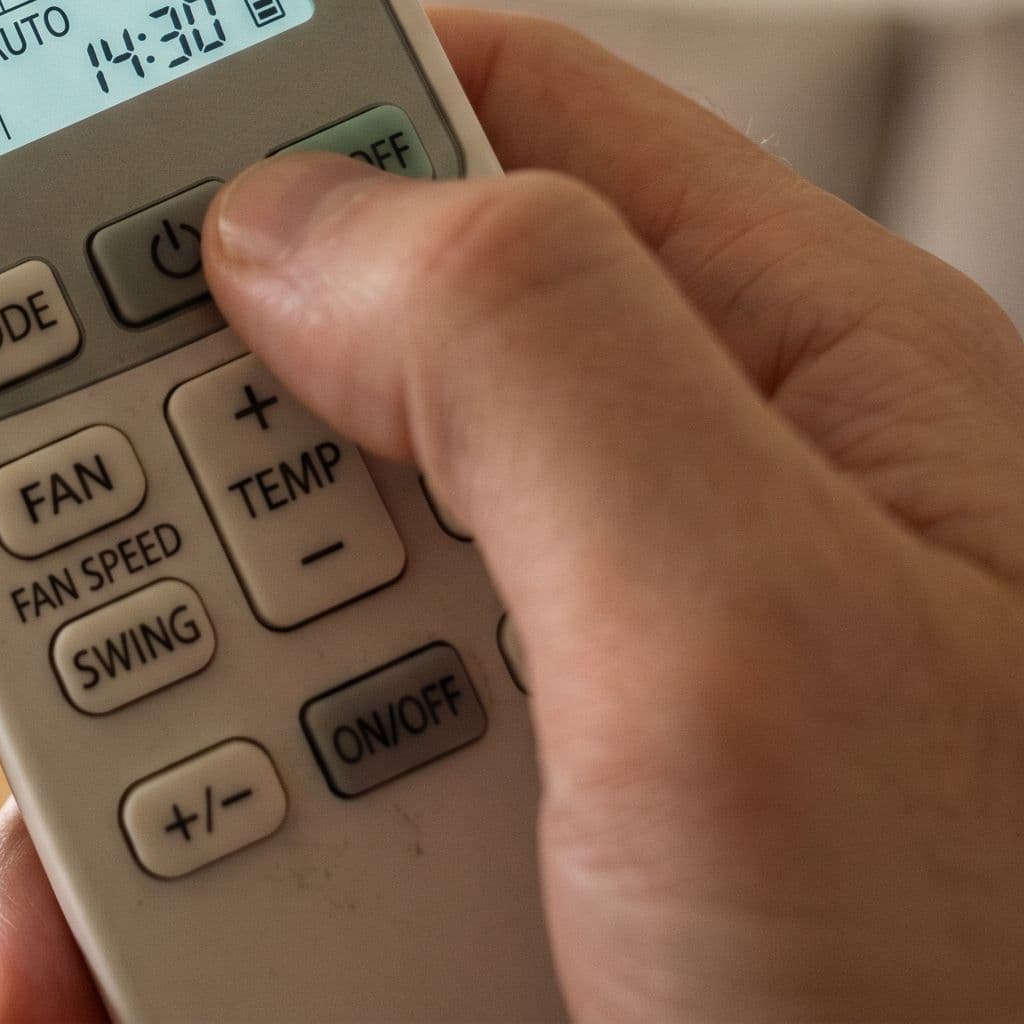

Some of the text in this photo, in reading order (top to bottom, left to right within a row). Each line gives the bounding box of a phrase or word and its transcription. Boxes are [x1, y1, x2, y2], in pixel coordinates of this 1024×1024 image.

[20, 454, 114, 523] FAN
[229, 440, 342, 519] TEMP
[10, 522, 182, 623] FAN SPEED
[73, 605, 202, 688] SWING
[332, 675, 463, 764] ON/OFF
